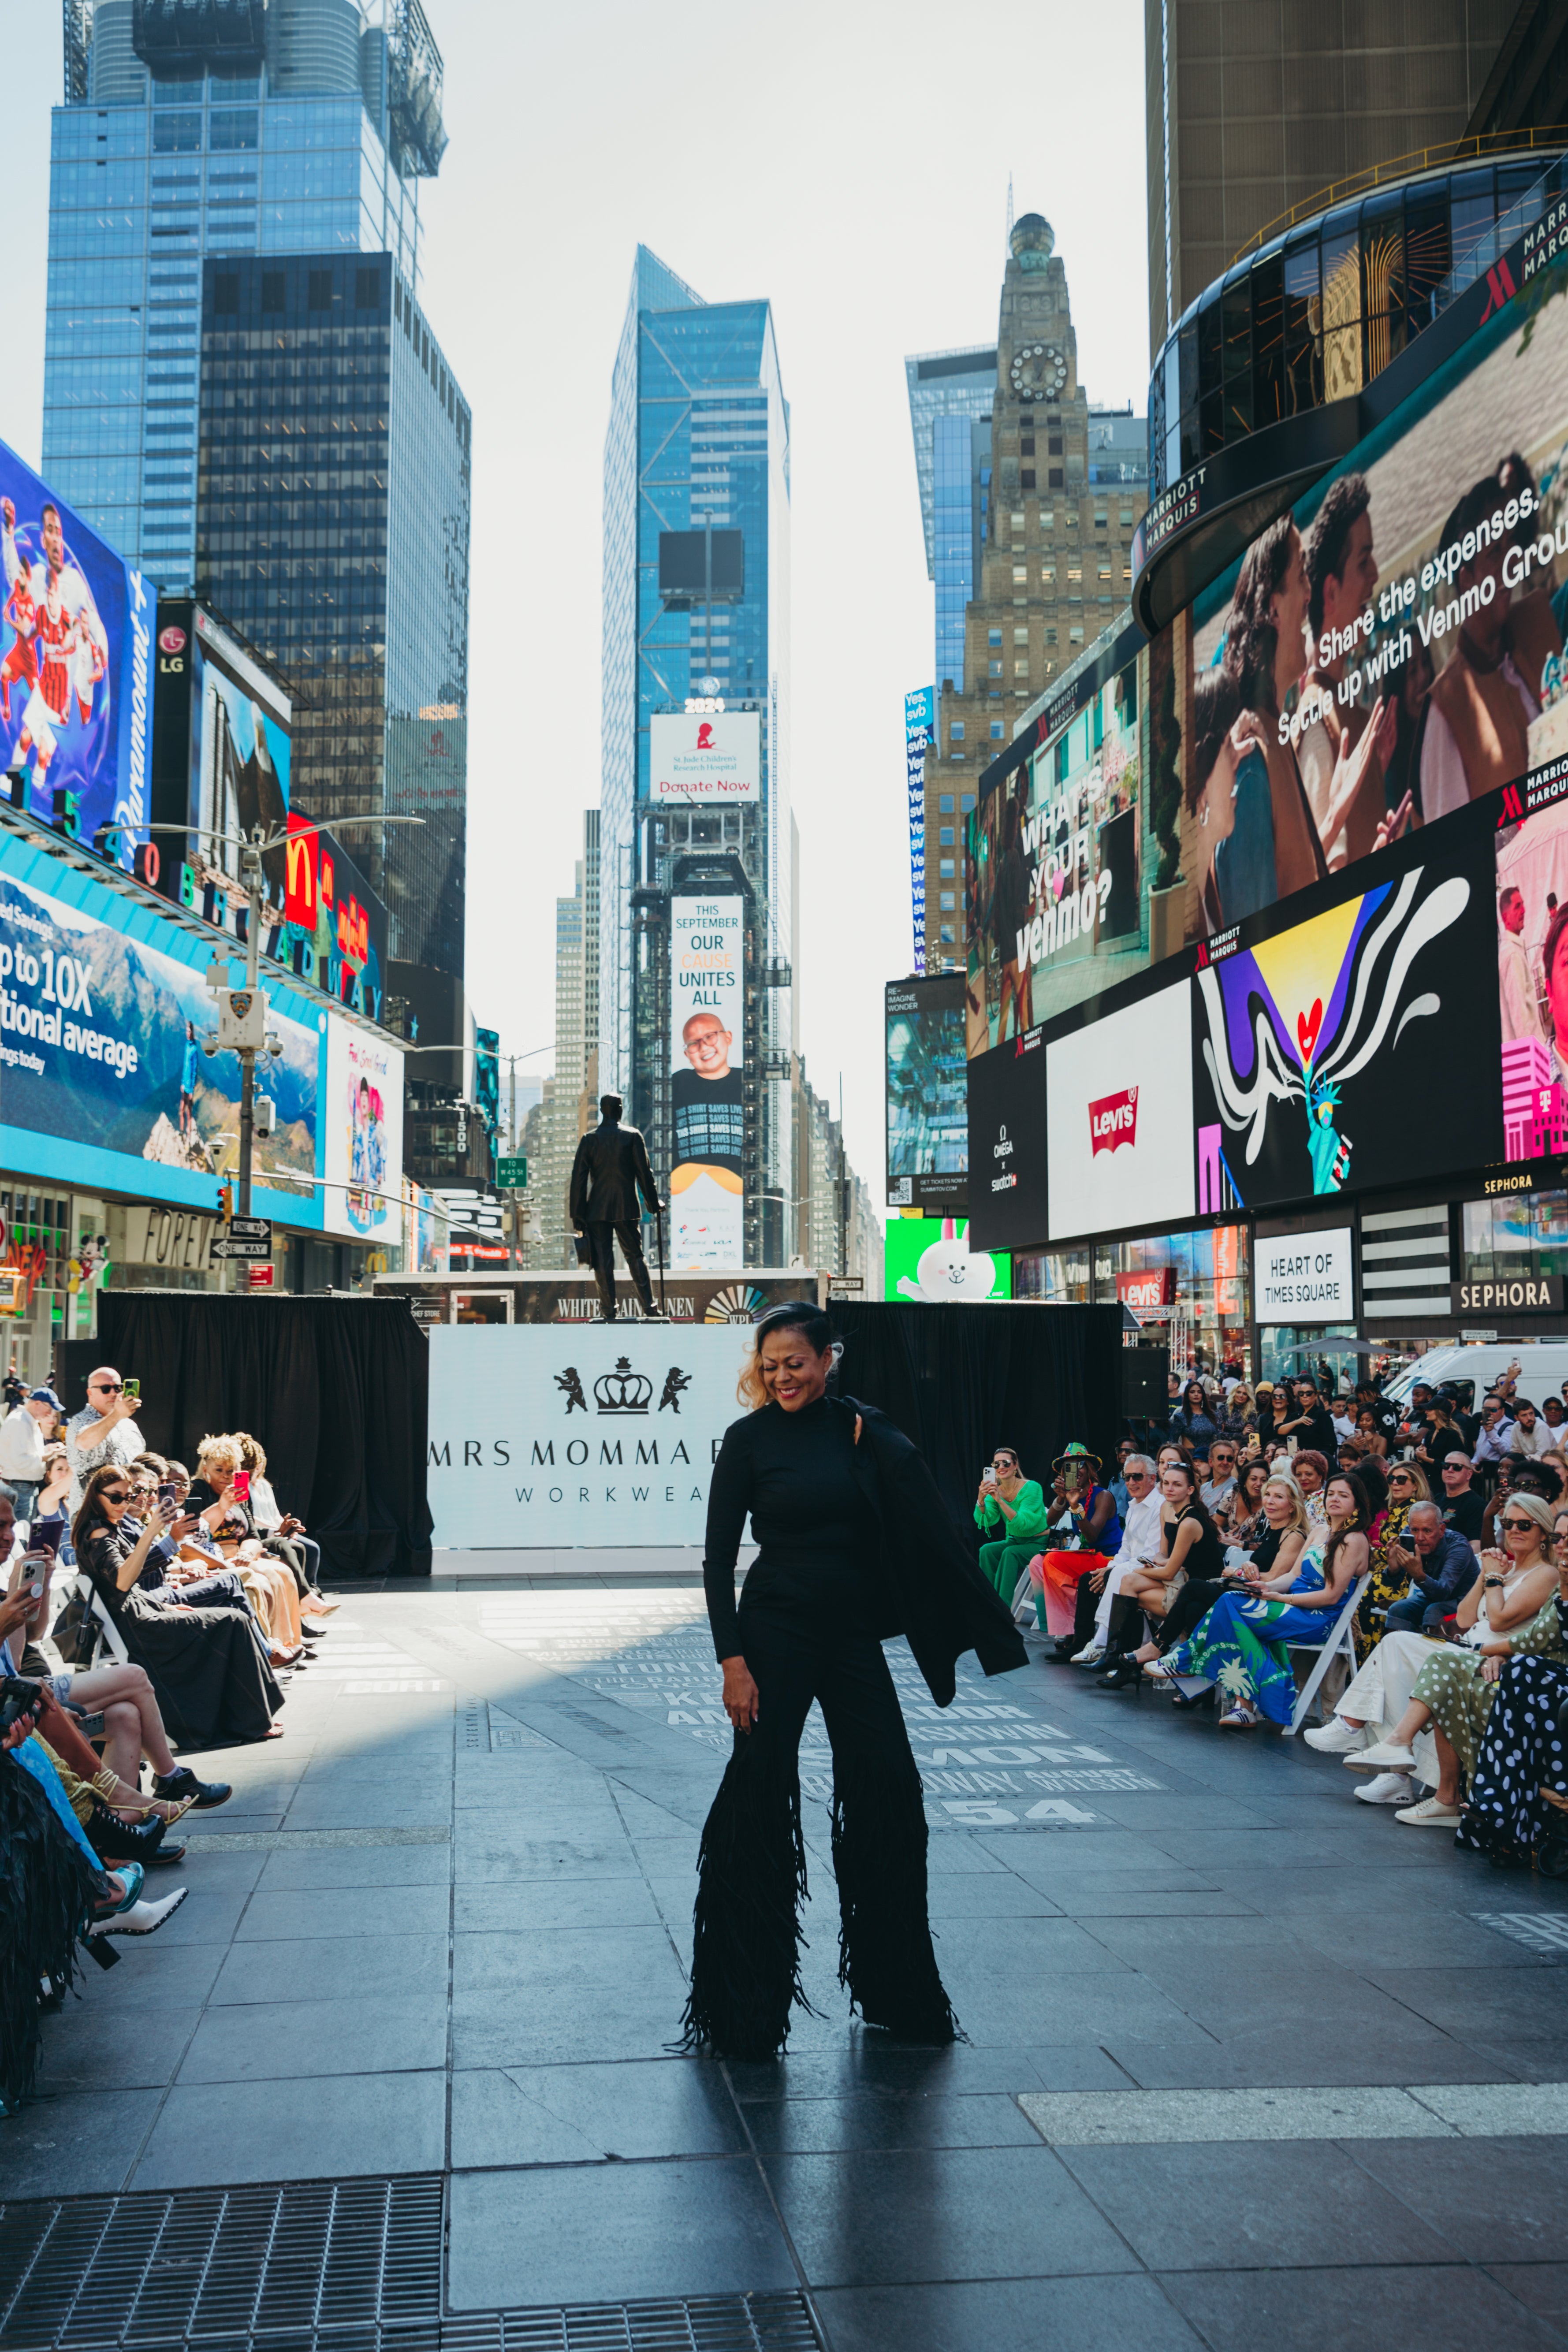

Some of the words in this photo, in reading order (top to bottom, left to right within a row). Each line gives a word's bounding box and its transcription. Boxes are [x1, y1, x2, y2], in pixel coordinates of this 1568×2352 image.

[1146, 466, 1207, 528] MARRIOTT
[1146, 497, 1199, 552] MARQUIS
[1318, 610, 1376, 669] Share
[1379, 574, 1416, 623] the
[1421, 487, 1540, 592] expenses.
[160, 657, 184, 673] LG
[1278, 686, 1334, 746] Settle
[1337, 670, 1362, 708] up
[1366, 637, 1412, 684] with
[1416, 576, 1495, 647] Venmo
[685, 698, 725, 714] 2024
[905, 692, 926, 706] Yes,
[1050, 683, 1079, 718] MARRIOTT
[907, 703, 926, 721] svb
[1050, 701, 1076, 732] MARQUIS
[906, 725, 928, 739] Yes,
[907, 735, 927, 753] svb
[707, 763, 737, 771] Hospital
[660, 782, 712, 793] Donate
[718, 781, 750, 791] Now
[1528, 778, 1568, 808] MARQU
[1022, 766, 1102, 856] WHAT'S
[15, 765, 160, 886] 1540
[696, 905, 719, 915] THIS
[14, 906, 54, 942] Savings
[676, 918, 738, 929] SEPTEMBER
[1017, 868, 1112, 973] venmo?
[691, 935, 724, 949] OUR
[1210, 926, 1240, 949] MARRIOTT
[1210, 941, 1237, 961] MARQUIS
[682, 953, 733, 968] CAUSE
[14, 942, 39, 986] to
[41, 949, 93, 1017] 10X
[679, 972, 735, 986] UNITES
[693, 990, 722, 1005] ALL
[888, 994, 916, 1004] IMAGINE
[887, 1002, 918, 1012] WONDER
[1024, 1027, 1042, 1042] MARRIOTT
[63, 1021, 138, 1079] average
[1024, 1038, 1041, 1051] MARQUIS
[19, 1049, 45, 1076] today
[687, 1104, 707, 1114] SHIRT
[708, 1104, 729, 1113] SAVES
[688, 1114, 708, 1124] SHIRT
[708, 1114, 730, 1123] SAVES
[1094, 1104, 1133, 1137] Levi's
[457, 1111, 466, 1153] 1500
[689, 1124, 708, 1135] SHIRT
[709, 1124, 730, 1134] SAVES
[690, 1134, 708, 1145] SHIRT
[710, 1134, 730, 1143] SAVES
[690, 1144, 709, 1156] SHIRT
[711, 1144, 730, 1154] SAVES
[994, 1140, 1013, 1158] OMEGA
[991, 1174, 1013, 1192] swatch
[1485, 1175, 1532, 1193] SEPHORA
[236, 1223, 249, 1232] ONE
[253, 1224, 265, 1232] WAY
[245, 1245, 264, 1253] WAY
[1271, 1256, 1310, 1278] HEART
[1315, 1254, 1333, 1273] OF
[1121, 1282, 1160, 1306] Levi's
[1265, 1287, 1293, 1304] TIMES
[1296, 1283, 1340, 1303] SQUARE
[1460, 1281, 1550, 1308] SEPHORA
[557, 1298, 601, 1319] WHITE
[427, 1440, 510, 1467] MRS
[531, 1439, 691, 1466] MOMMA
[515, 1486, 703, 1503] WORKWEA
[618, 1661, 723, 1674] FONT
[466, 1714, 479, 1748] SEVENTH
[1024, 1769, 1136, 1779] AUGUST
[1031, 1777, 1164, 1791] WILSON
[940, 1799, 1098, 1824] 54
